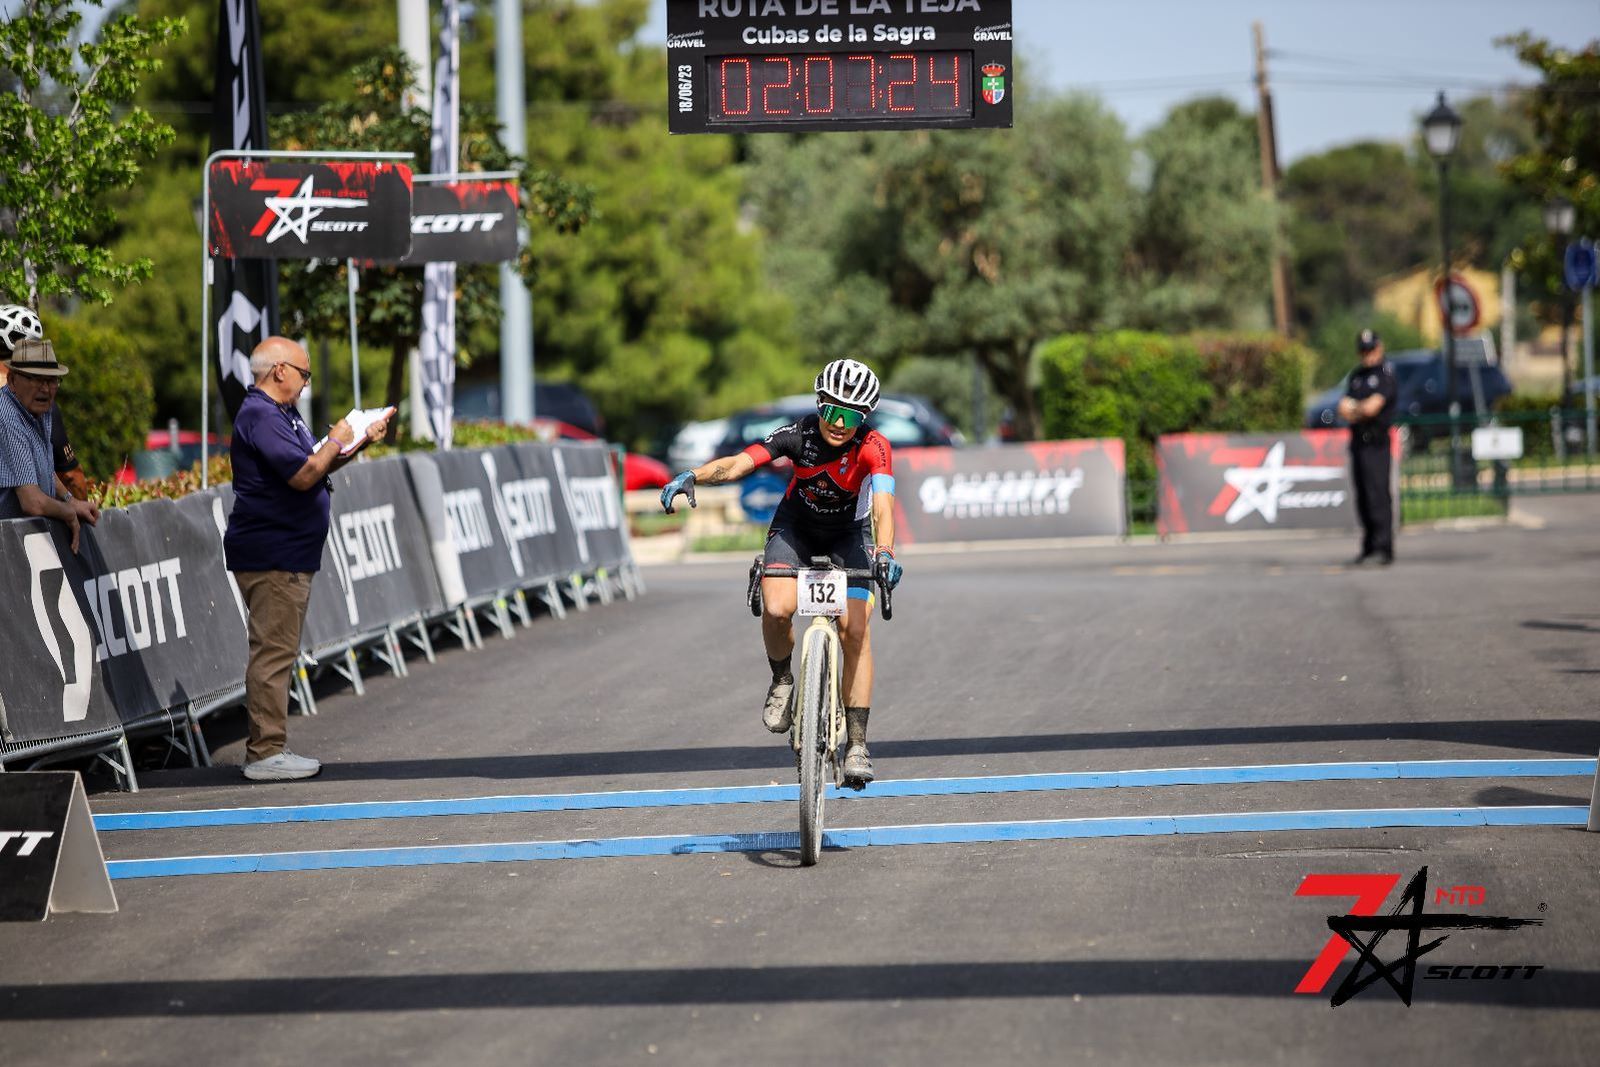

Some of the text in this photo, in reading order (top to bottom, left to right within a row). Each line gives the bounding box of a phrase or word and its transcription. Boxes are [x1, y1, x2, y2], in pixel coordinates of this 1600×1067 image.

[698, 0, 787, 18] RUTA
[796, 0, 839, 16] DE
[849, 0, 892, 15] LA
[666, 38, 706, 49] GRAVEL
[742, 23, 936, 45] Cubas de la Sagra
[973, 31, 1013, 42] GRAVEL
[678, 64, 693, 113] 18/06/23
[721, 55, 960, 115] 02:07:24
[310, 221, 369, 232] SCOTT
[410, 212, 504, 234] COTT
[501, 476, 556, 541] SCOTT
[339, 503, 402, 582] SCOTT
[808, 582, 836, 604] 132
